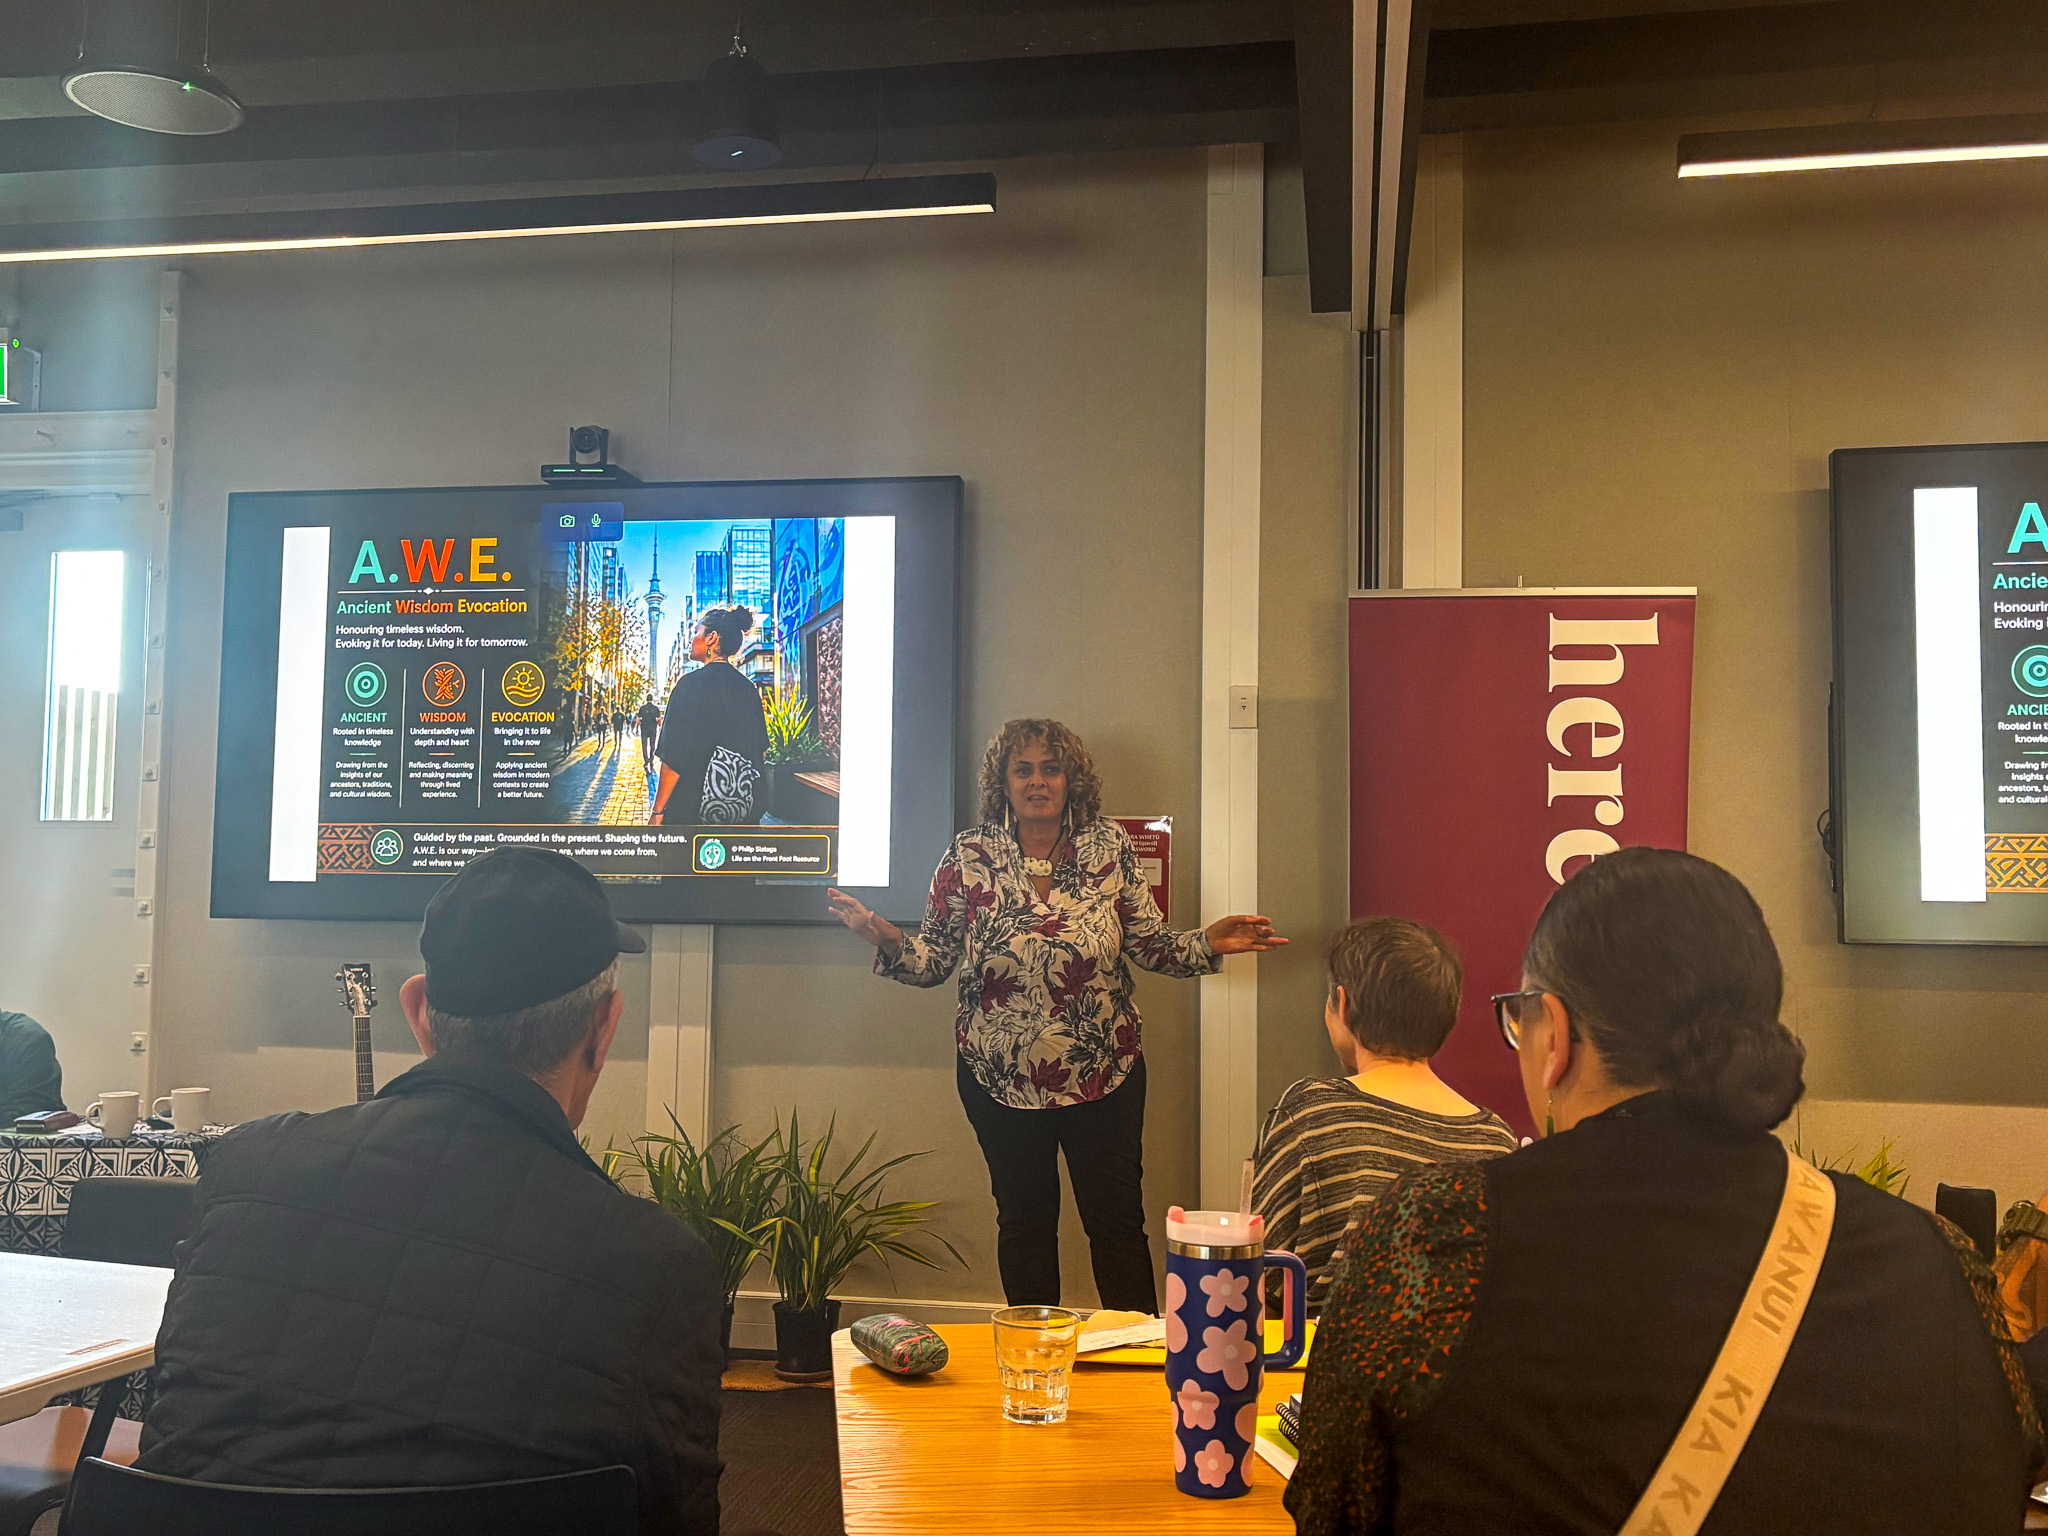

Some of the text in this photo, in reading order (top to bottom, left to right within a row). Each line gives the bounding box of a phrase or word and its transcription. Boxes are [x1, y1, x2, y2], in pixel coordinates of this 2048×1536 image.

[348, 537, 512, 584] A.W.E.
[337, 598, 528, 615] Ancient Wisdom Evocation
[1994, 617, 2044, 631] Evoking
[336, 624, 464, 637] Honouring timeless wisdom.
[335, 637, 528, 651] Evoking it for today. Living it for tomorrow.
[340, 712, 387, 723] ANCIENT
[419, 712, 467, 723] WISDOM
[491, 712, 555, 723] EVOCATION
[1998, 721, 2031, 730] Rooted
[2032, 721, 2042, 730] in
[332, 727, 394, 735] Rooted in timeless
[410, 727, 475, 736] Understanding with
[494, 727, 552, 736] Bringing it to life
[344, 738, 382, 747] knowledge
[414, 738, 470, 747] depth and heart
[503, 738, 511, 746] in
[512, 738, 524, 746] the
[335, 761, 388, 770] Drawing from the
[408, 761, 475, 770] Reflecting, discerning
[495, 761, 548, 770] Applying ancient
[2004, 761, 2039, 771] Drawing
[340, 771, 364, 779] insights
[422, 771, 445, 779] making
[446, 771, 473, 779] meaning
[2011, 772, 2044, 782] insights
[420, 781, 445, 789] through
[1998, 785, 2042, 793] ancestors,
[422, 791, 458, 799] experience.
[1998, 795, 2015, 803] and
[413, 832, 688, 845] Guided by the past. Grounded in the present. Shaping the future.
[413, 846, 438, 855] A.W.E.
[438, 846, 446, 855] is
[574, 847, 599, 856] where
[613, 848, 637, 856] come
[638, 847, 658, 857] from,
[738, 845, 755, 853] Philip
[412, 859, 427, 867] and
[428, 859, 452, 867] where
[1689, 1373, 1754, 1454] KIA
